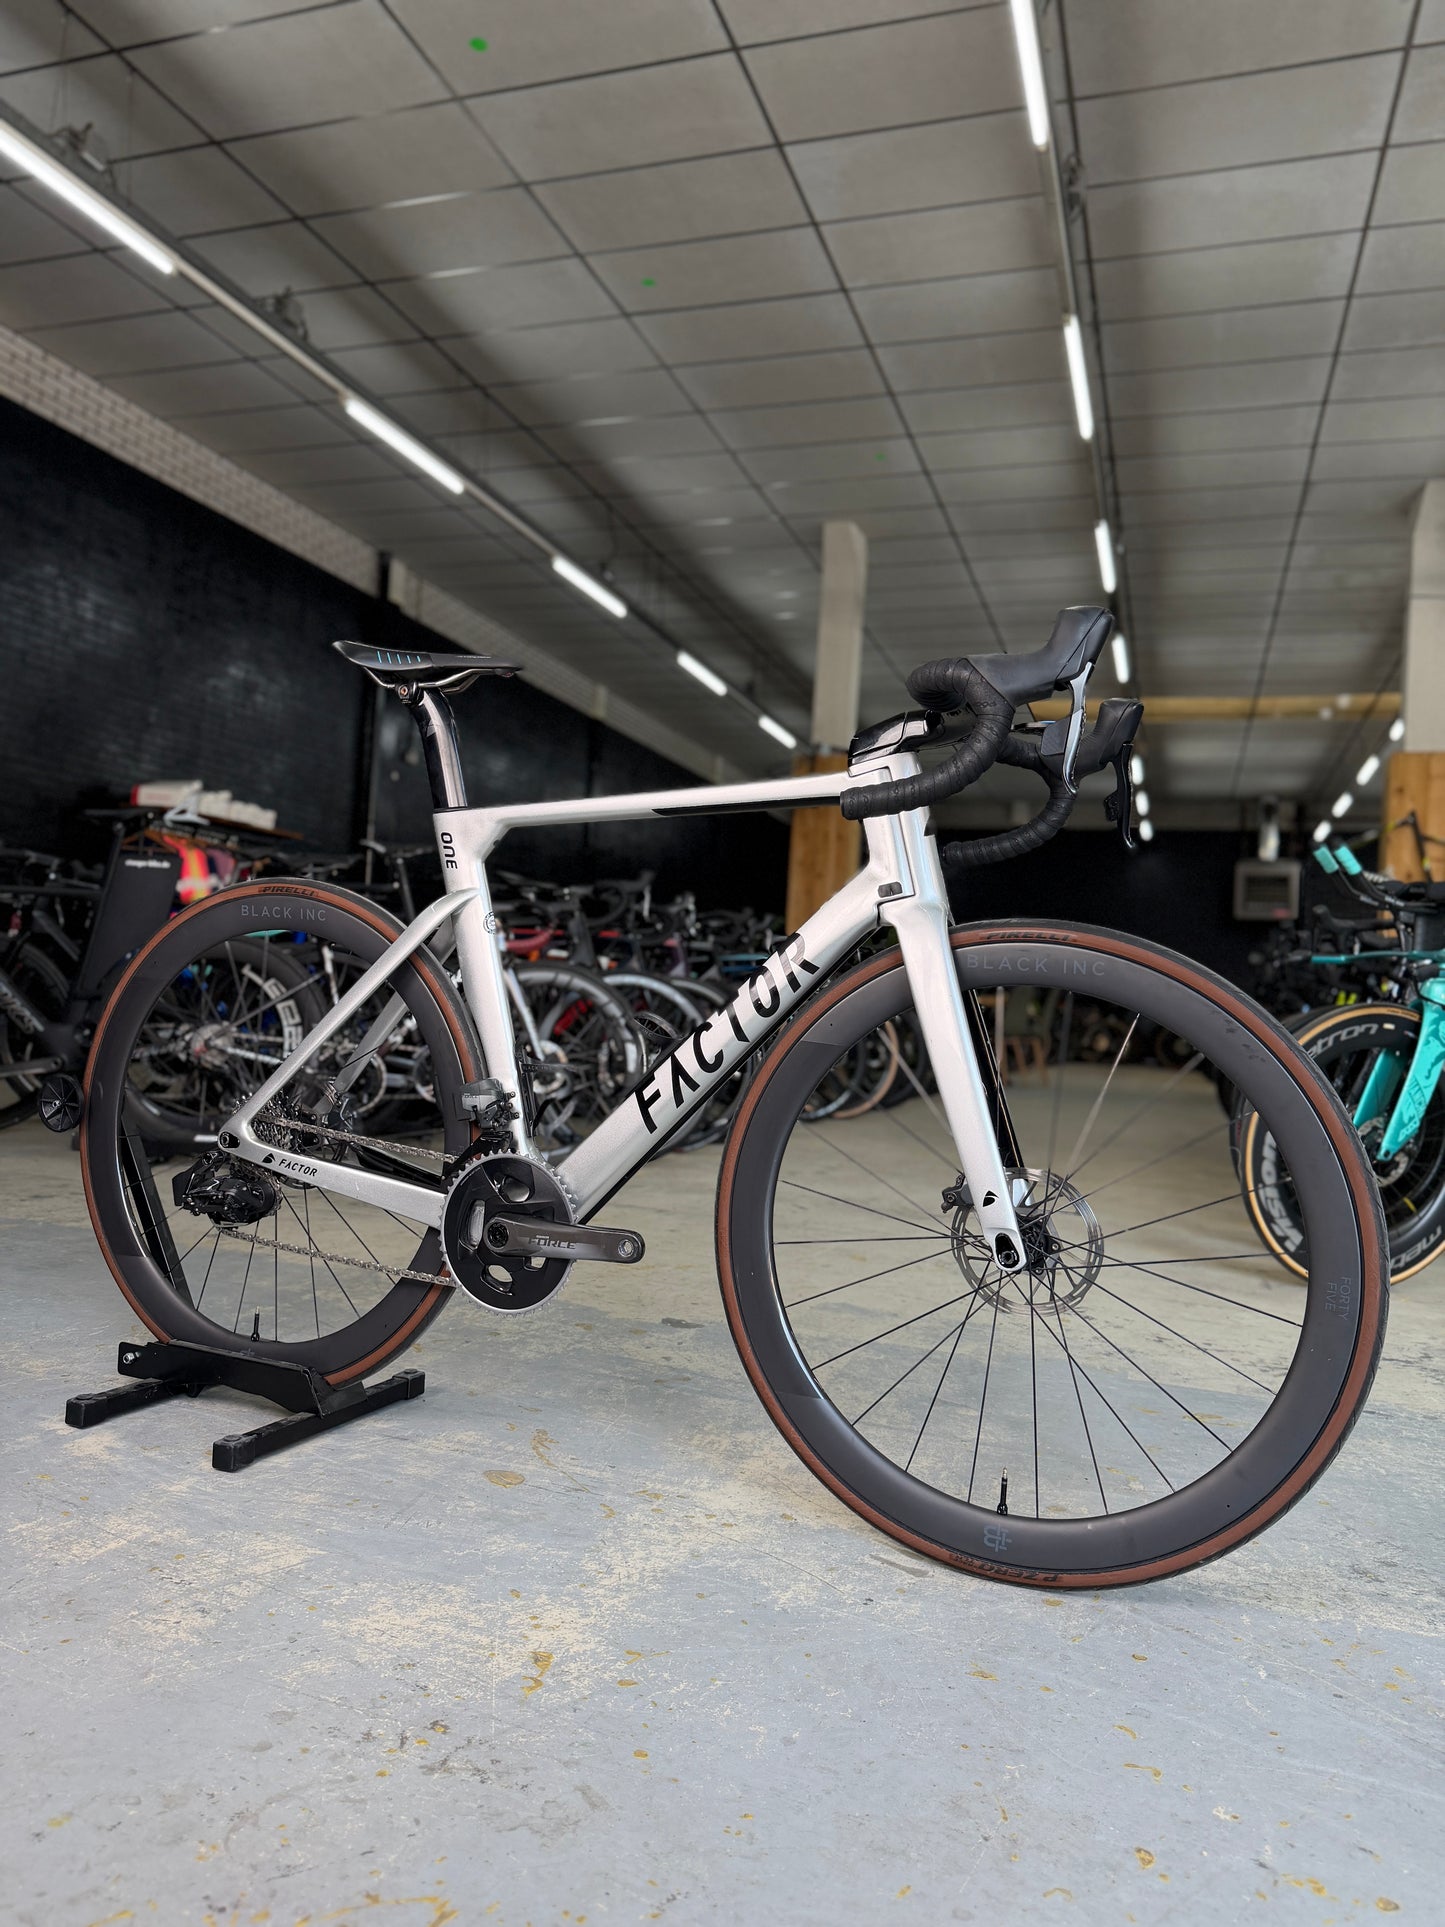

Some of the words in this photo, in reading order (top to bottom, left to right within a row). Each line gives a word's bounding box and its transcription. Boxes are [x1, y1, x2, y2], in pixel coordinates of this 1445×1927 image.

[440, 832, 458, 870] ONE
[261, 885, 315, 897] PIRELLI
[241, 904, 292, 919] BLACK
[300, 907, 327, 921] INC
[985, 931, 1072, 942] PIRELLI
[967, 954, 1049, 973] BLACK
[1063, 959, 1106, 976] INC
[631, 932, 820, 1135] FACTOR
[1306, 1023, 1379, 1060] etron
[278, 1158, 318, 1177] FACTOR
[528, 1237, 577, 1250] FORCE
[1324, 1282, 1338, 1312] FIVE
[1338, 1276, 1352, 1321] FORTY
